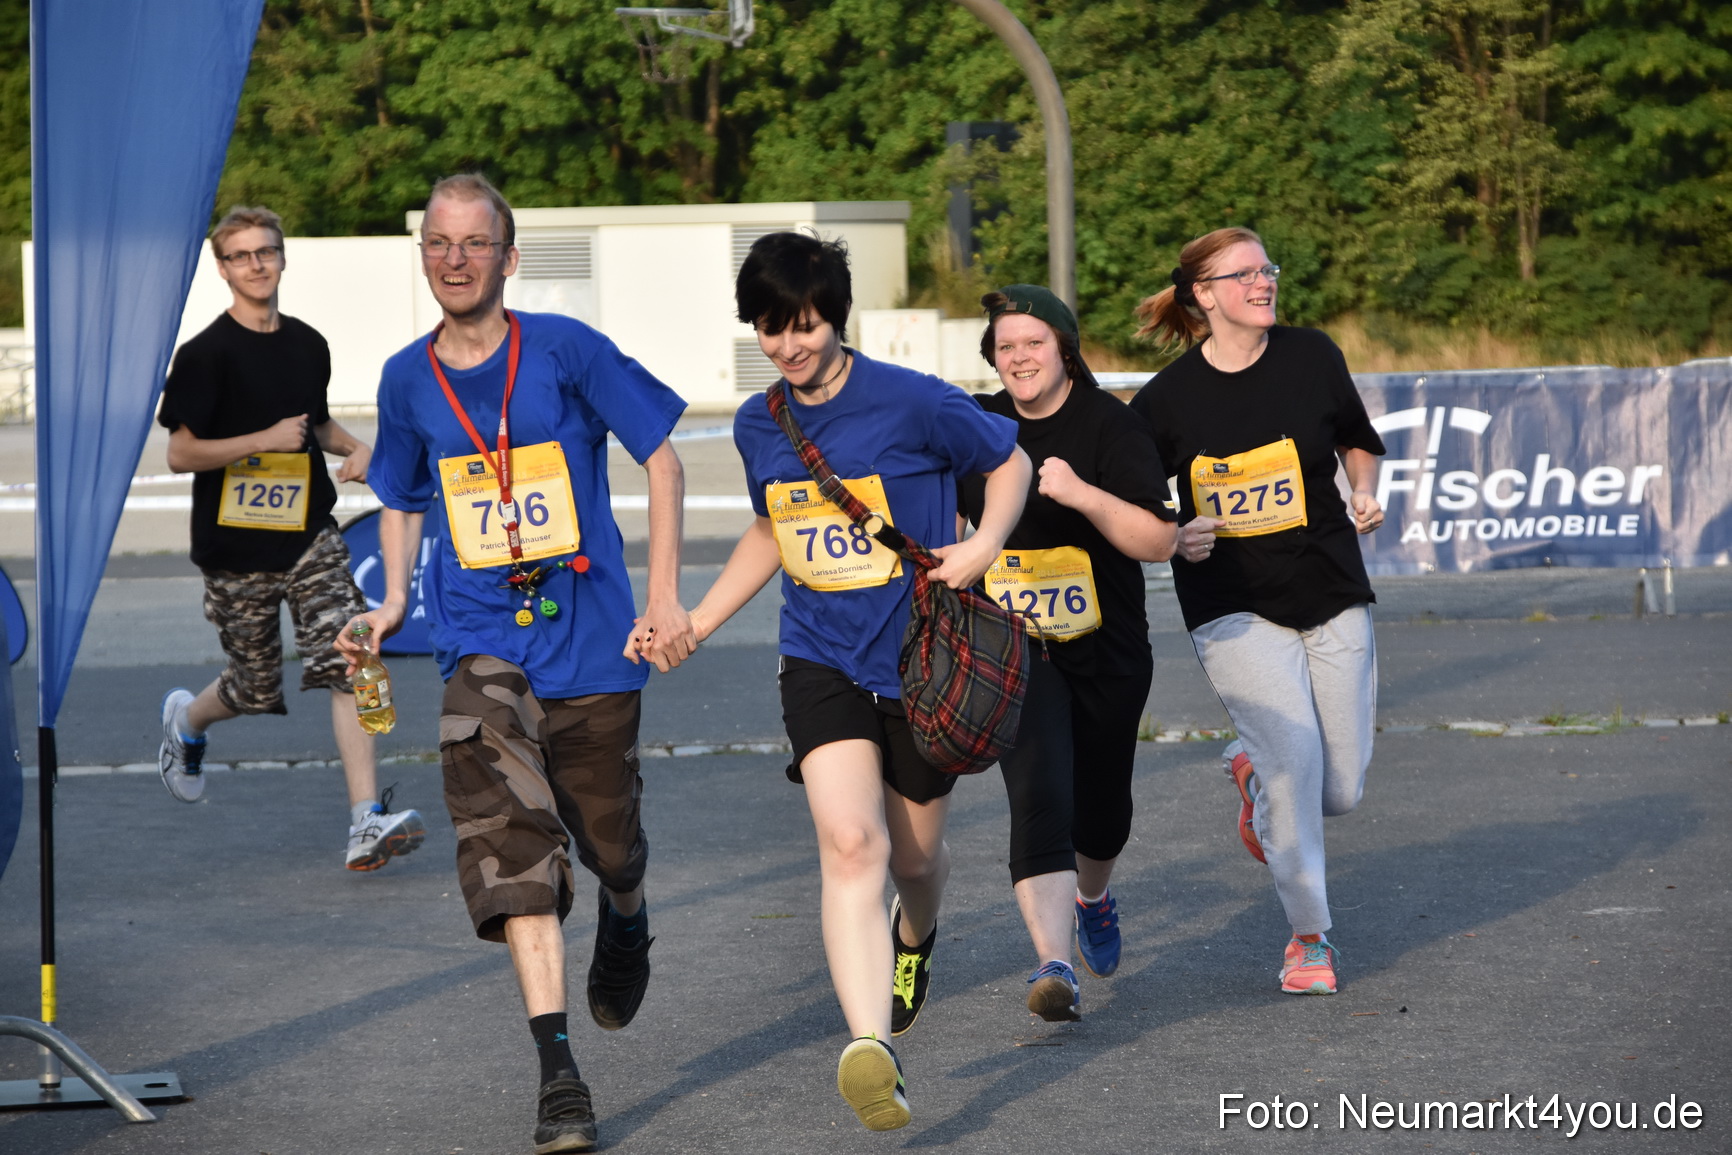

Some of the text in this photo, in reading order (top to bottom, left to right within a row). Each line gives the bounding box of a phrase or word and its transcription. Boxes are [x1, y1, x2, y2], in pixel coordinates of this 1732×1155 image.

[461, 472, 498, 483] firmenlau
[1376, 453, 1663, 513] Fischer
[233, 482, 301, 509] 1267
[1206, 478, 1294, 516] 1275
[784, 499, 825, 511] firmenlauf
[775, 514, 809, 524] walken
[1252, 514, 1278, 524] Krutsch
[1400, 514, 1640, 545] AUTOMOBILE
[480, 541, 505, 550] Patrick
[795, 523, 872, 562] 768
[811, 563, 872, 577] Larissa Dornisch
[1000, 565, 1034, 574] firmenlauf
[998, 585, 1087, 619] 1276
[1053, 622, 1070, 630] Weiß
